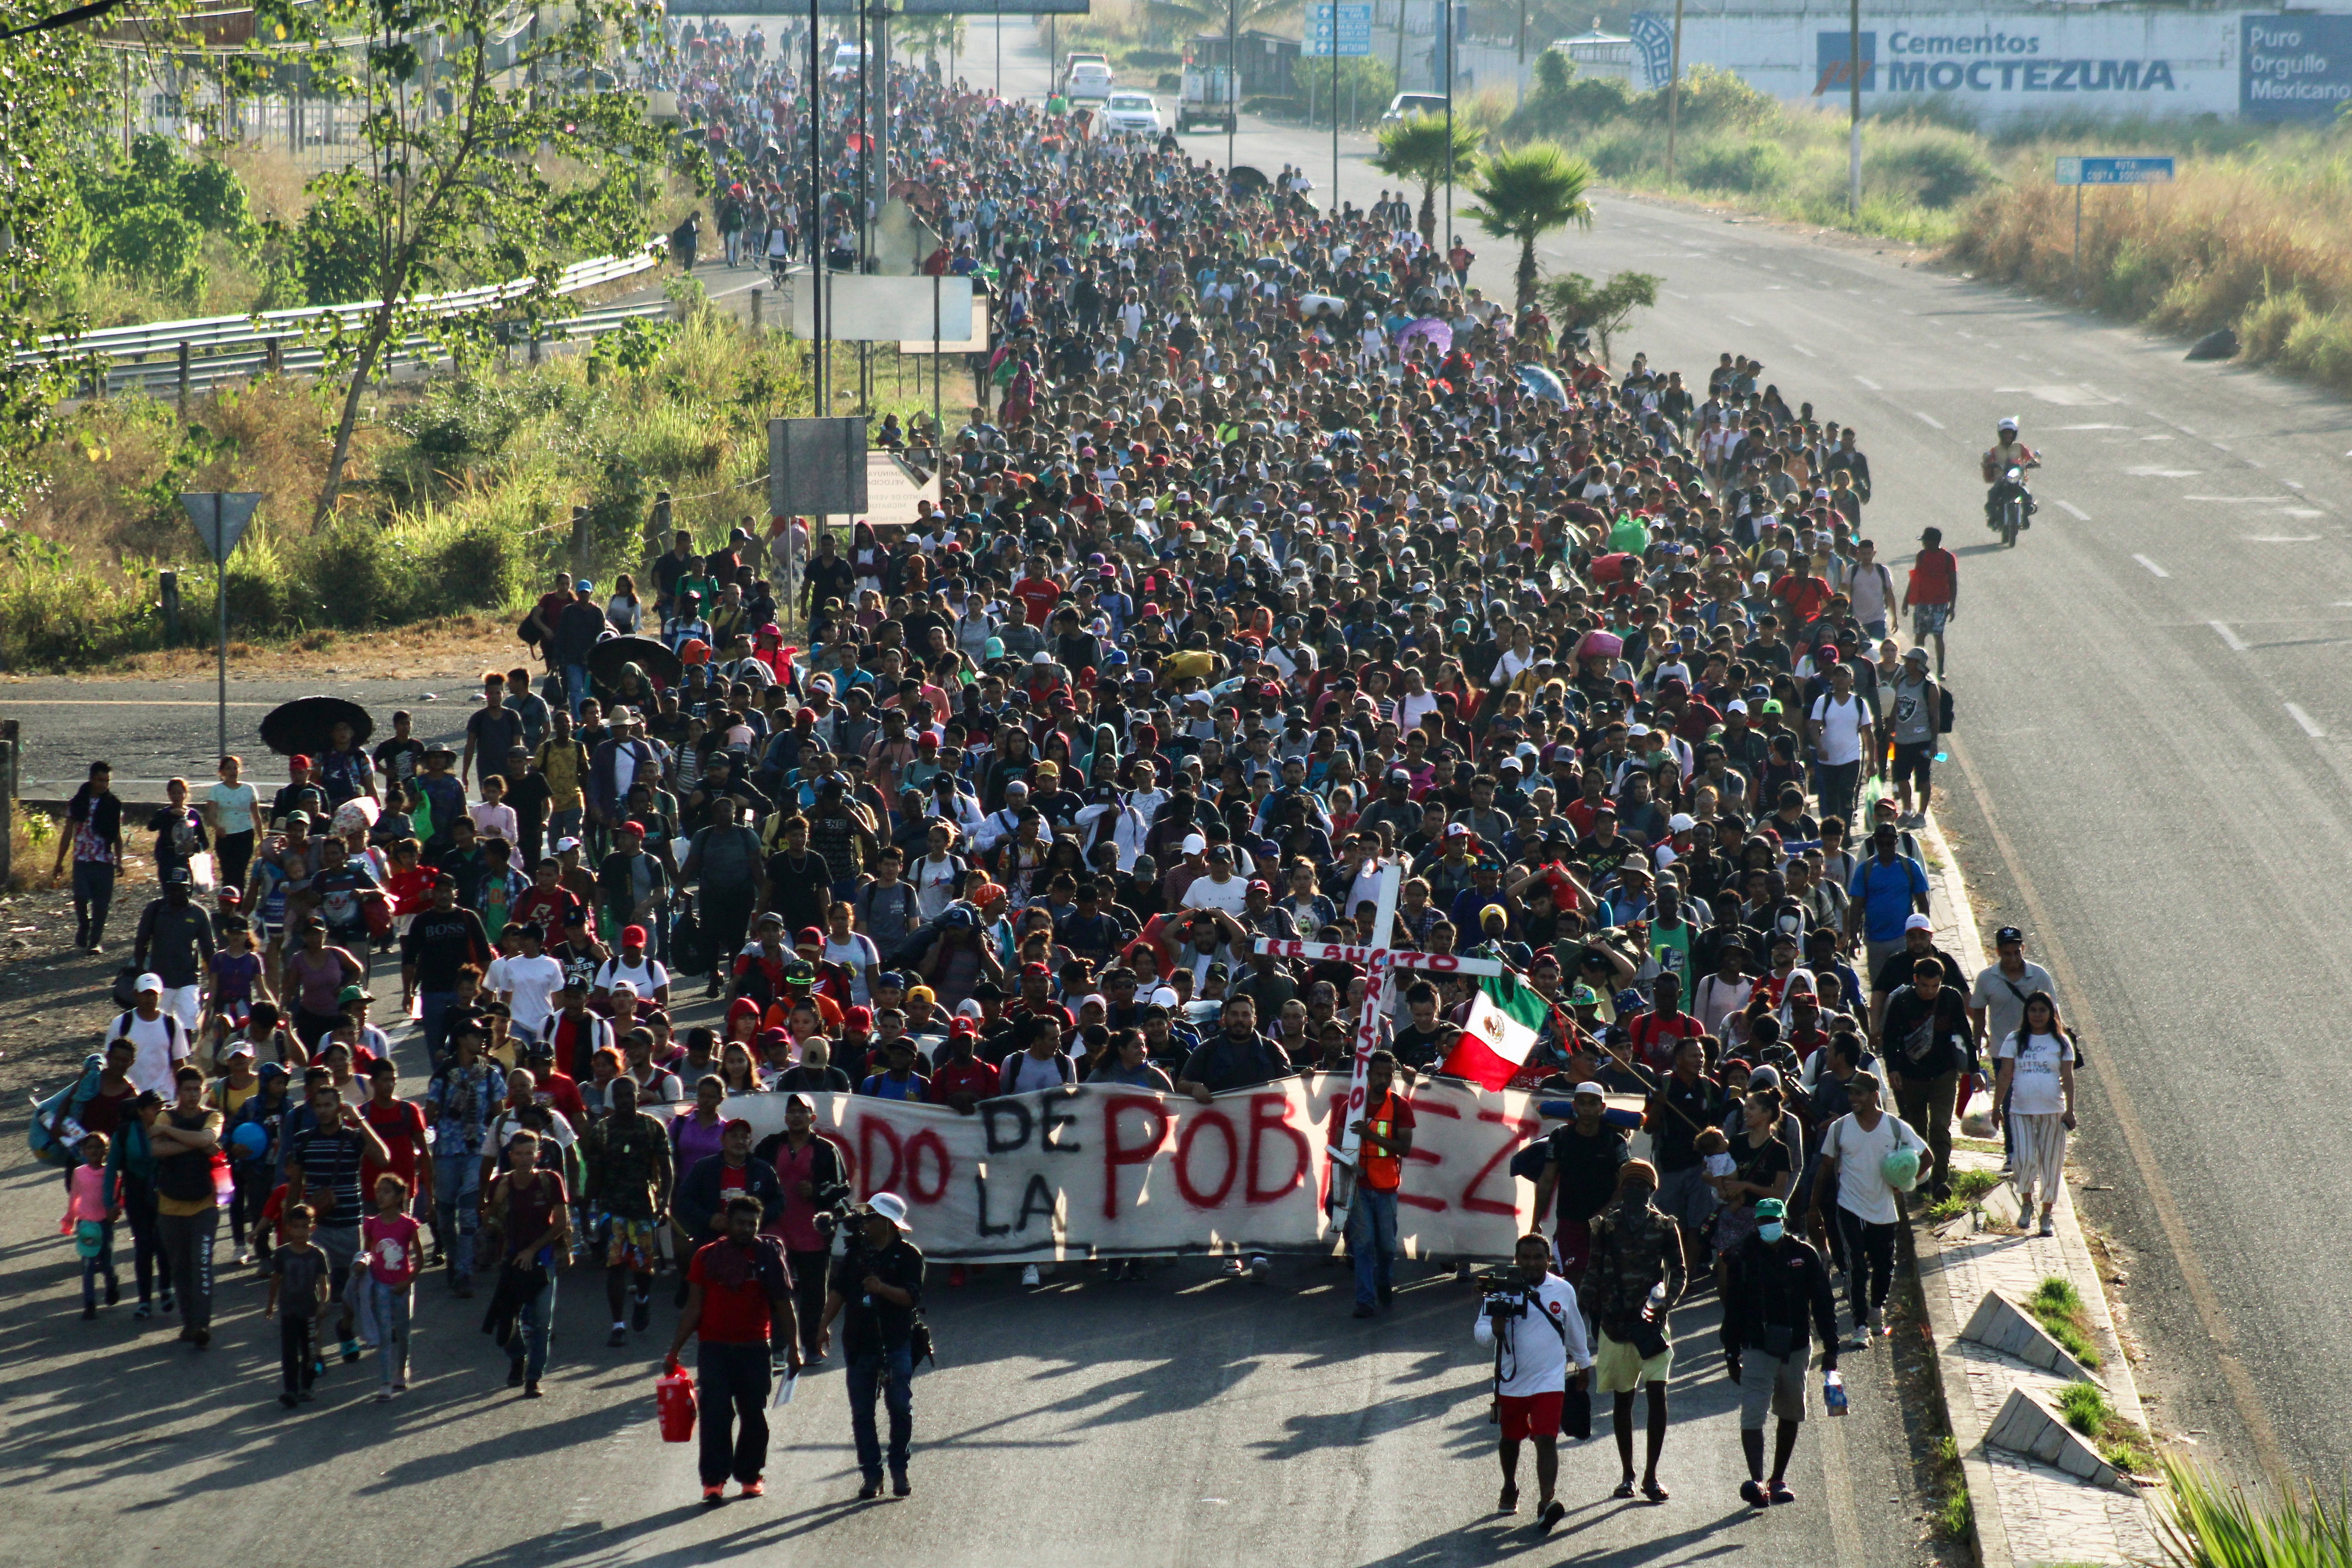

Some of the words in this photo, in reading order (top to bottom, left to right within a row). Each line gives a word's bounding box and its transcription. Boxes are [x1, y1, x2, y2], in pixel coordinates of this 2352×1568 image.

[1888, 32, 2039, 54] Cementos
[2251, 27, 2300, 47] Puro
[1888, 60, 2175, 92] MOCTEZUMA
[2251, 54, 2327, 79] Orgullo
[2251, 79, 2351, 100] Mexicano
[2115, 161, 2136, 170] RUTA
[425, 923, 465, 937] BOSS
[980, 1085, 1083, 1154] DE
[975, 1174, 1066, 1237] LA
